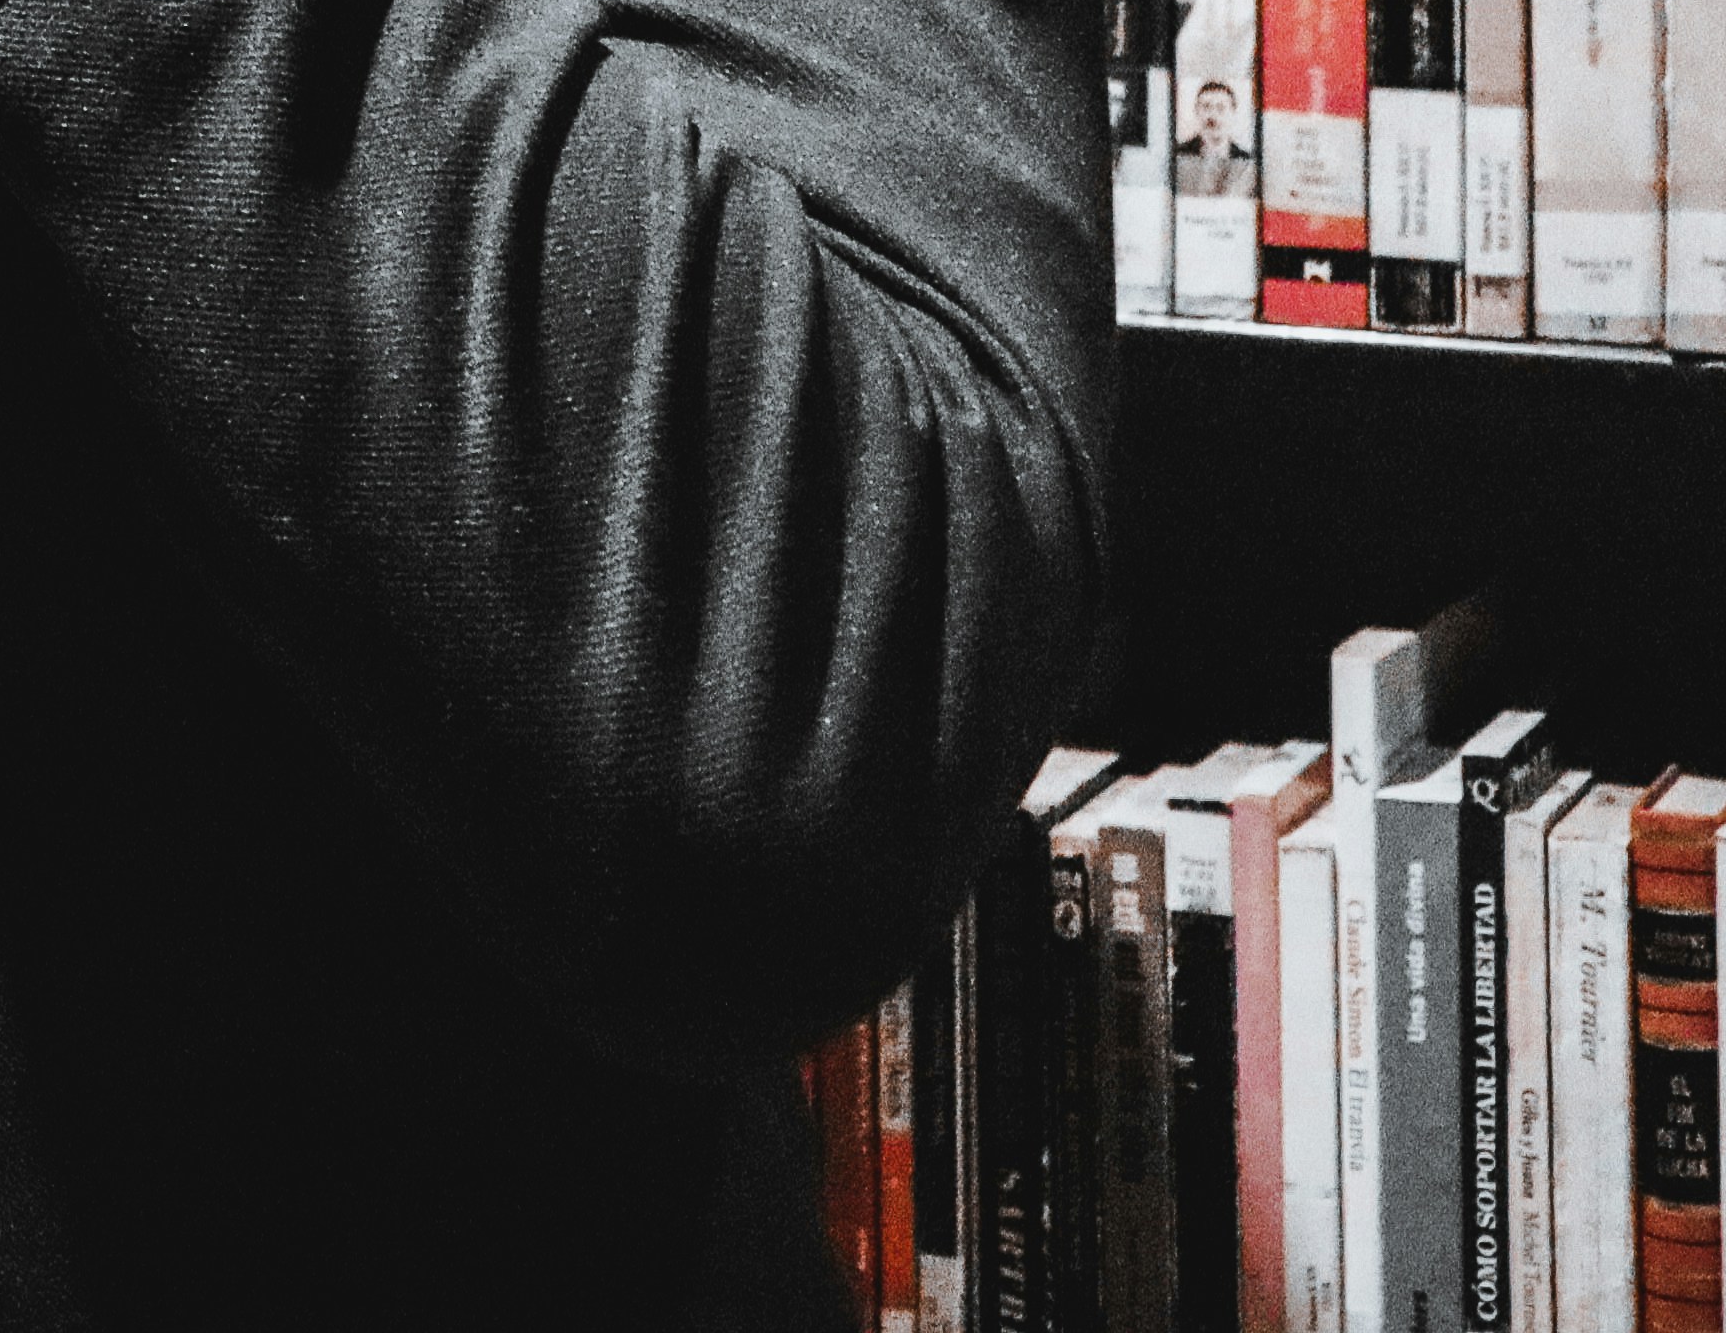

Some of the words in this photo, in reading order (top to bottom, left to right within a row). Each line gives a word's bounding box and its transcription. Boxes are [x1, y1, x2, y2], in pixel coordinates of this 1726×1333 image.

[1405, 860, 1427, 936] divina
[1580, 882, 1606, 922] M.
[1405, 940, 1427, 990] vida
[1471, 882, 1497, 1029] LIBERTAD
[1407, 997, 1428, 1044] Una
[1579, 939, 1607, 1067] Tournier
[1473, 1032, 1497, 1071] LA
[1474, 1075, 1499, 1230] SOPORTAR
[1470, 1234, 1499, 1322] CÓMO
